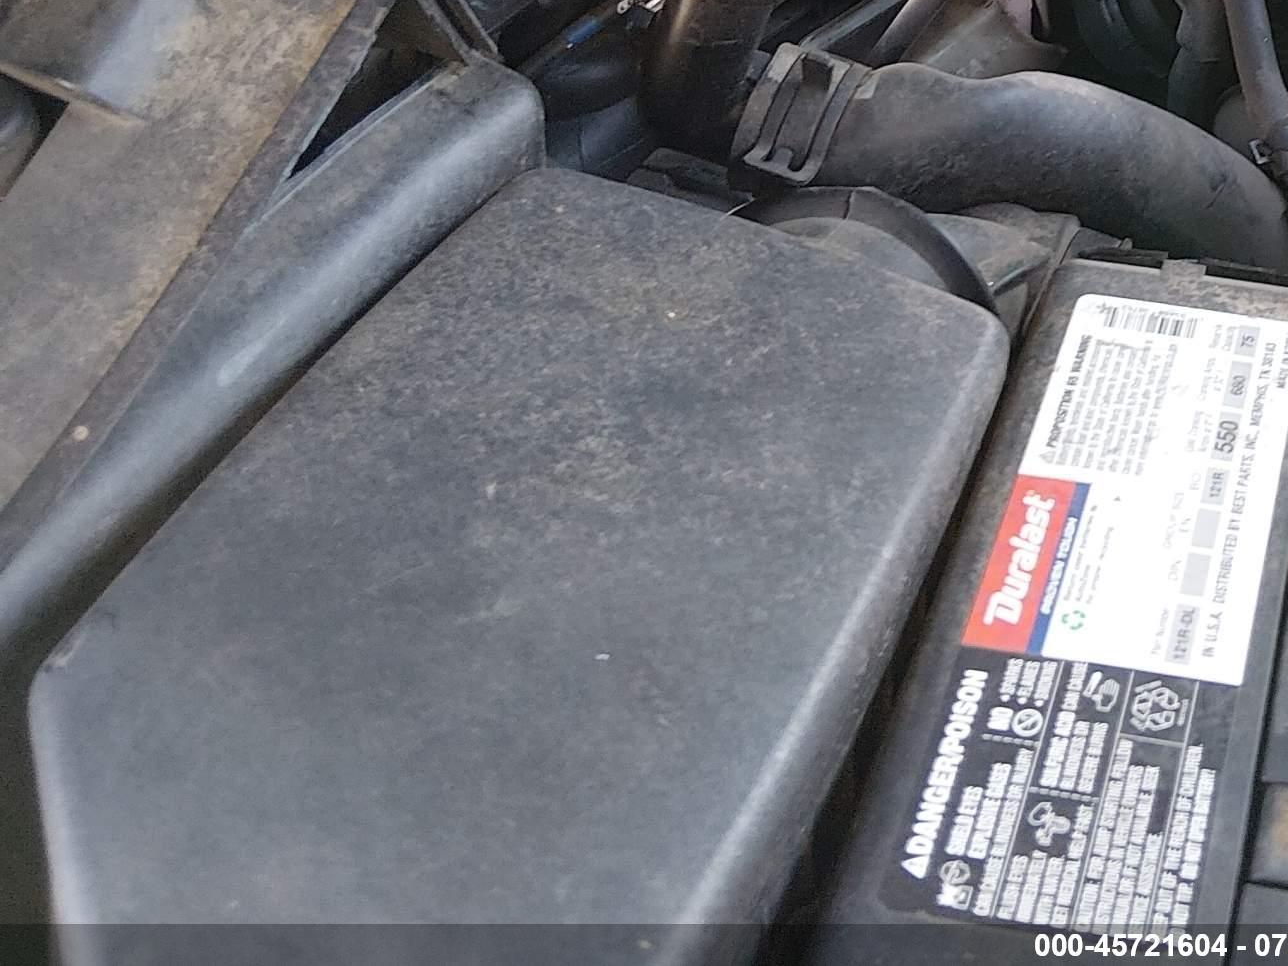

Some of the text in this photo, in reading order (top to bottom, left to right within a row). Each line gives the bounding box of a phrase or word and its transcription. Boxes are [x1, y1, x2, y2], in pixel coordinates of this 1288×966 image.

[1240, 333, 1255, 347] 75
[1229, 374, 1246, 396] 680
[1257, 367, 1270, 380] TN
[1276, 367, 1288, 388] MADE
[1046, 388, 1075, 448] PROPOSITION
[1070, 334, 1092, 372] WARNING
[1214, 419, 1238, 452] 550
[1208, 471, 1224, 498] 121R
[1231, 489, 1247, 514] BEST
[1227, 517, 1241, 531] BY
[981, 492, 1056, 628] Duralast
[1039, 516, 1078, 613] PROVEN TOUGH
[1213, 534, 1238, 603] DISTRIBUTED
[1172, 606, 1195, 660] 121R-DL
[1202, 645, 1217, 658] IN
[987, 706, 1013, 730] NO
[903, 669, 988, 855] DANGER/POISON
[944, 785, 982, 854] SHIELD EYES
[967, 762, 1011, 857] EXPLOSIVE GASES
